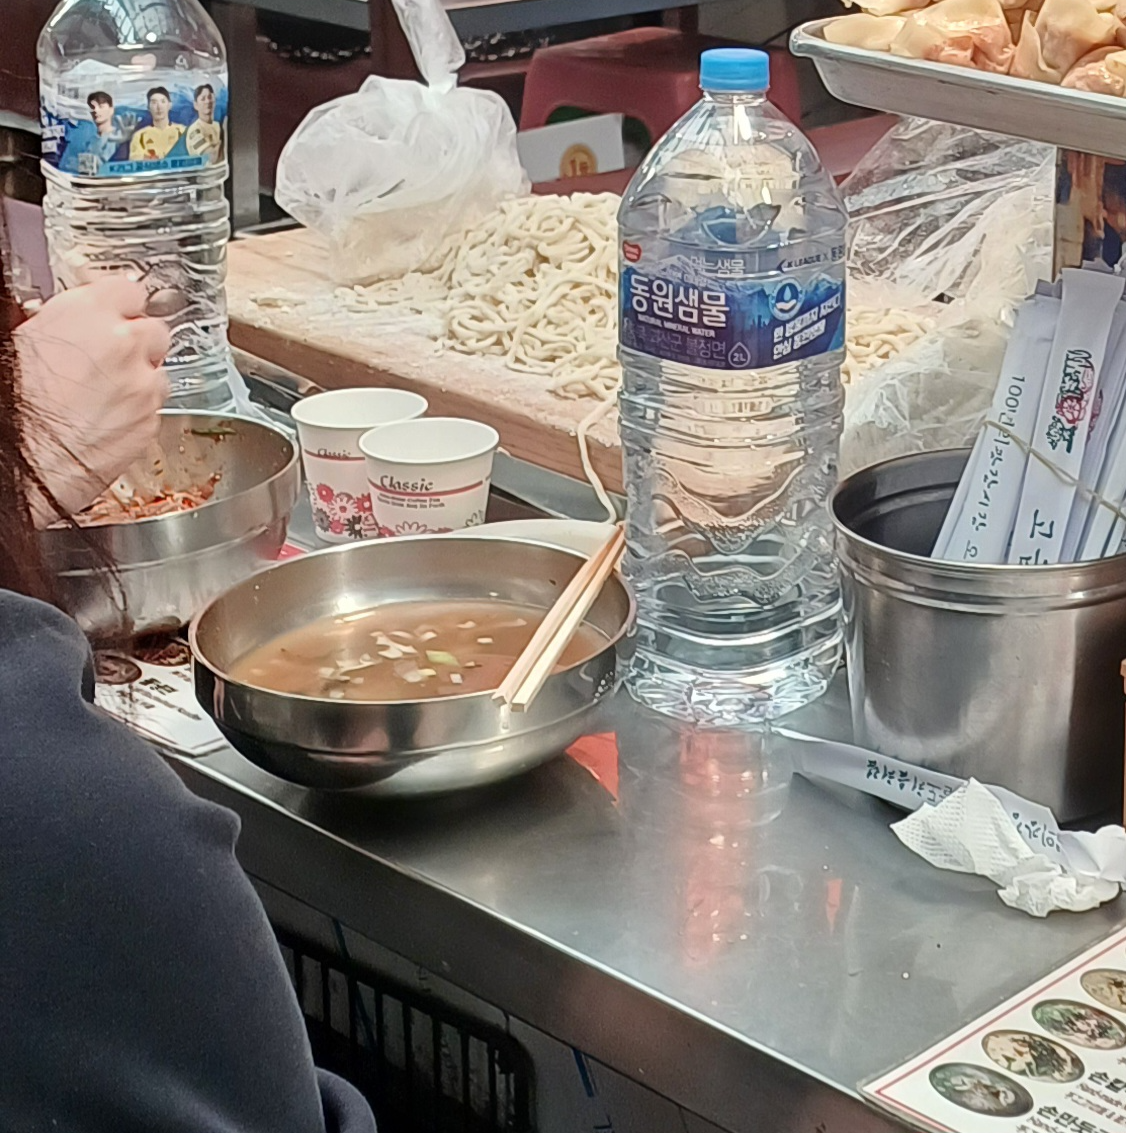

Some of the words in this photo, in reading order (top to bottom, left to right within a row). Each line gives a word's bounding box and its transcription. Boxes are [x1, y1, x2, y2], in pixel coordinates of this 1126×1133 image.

[629, 273, 730, 328] 동원샘물
[732, 352, 747, 362] 2L
[380, 474, 434, 491] Classic
